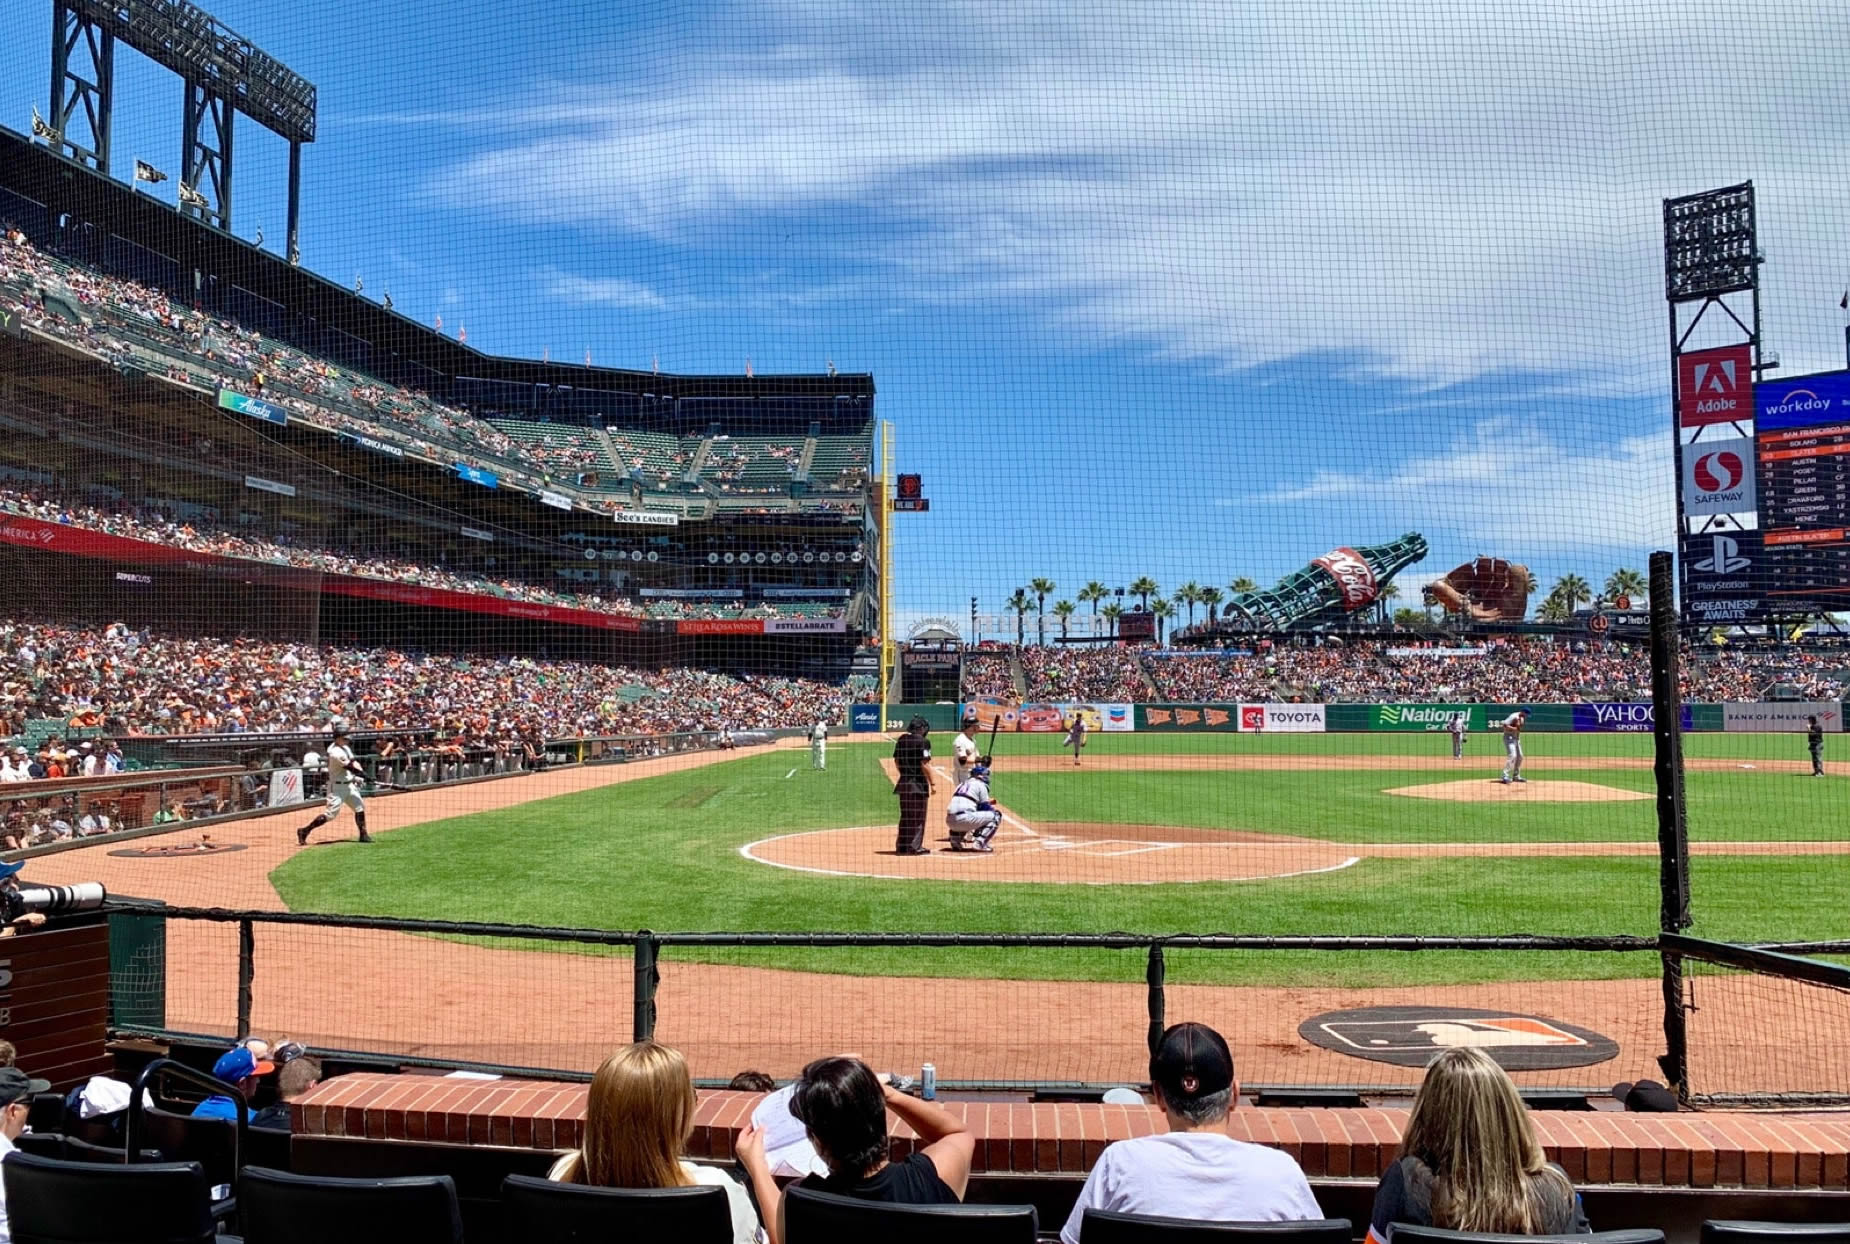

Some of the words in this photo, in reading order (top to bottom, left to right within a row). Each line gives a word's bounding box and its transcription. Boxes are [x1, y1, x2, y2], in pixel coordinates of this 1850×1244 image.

[239, 399, 272, 419] Alaska
[1696, 398, 1736, 413] Adobe
[1766, 399, 1830, 415] workday
[1783, 431, 1798, 439] SAN
[1800, 426, 1840, 437] FRANCISCO
[1789, 439, 1817, 447] SOLANO
[1695, 492, 1743, 503] SAFEWAY
[1787, 495, 1825, 504] CRAWFORD
[617, 512, 640, 523] See's
[643, 515, 675, 524] CANDIES
[116, 572, 151, 584] SUPERCUTS
[1697, 581, 1749, 592] PlayStation
[1692, 600, 1758, 611] GREATNESS
[1704, 609, 1745, 620] AWAITS
[711, 623, 733, 632] ROSA
[904, 654, 936, 665] ORACLE
[937, 654, 959, 665] PARK
[855, 713, 878, 721] Alaska
[1270, 713, 1321, 723] TOYOTA
[1401, 707, 1472, 722] National
[1728, 713, 1754, 721] BANK
[1770, 713, 1809, 721] AMERIC
[886, 720, 904, 729] 339
